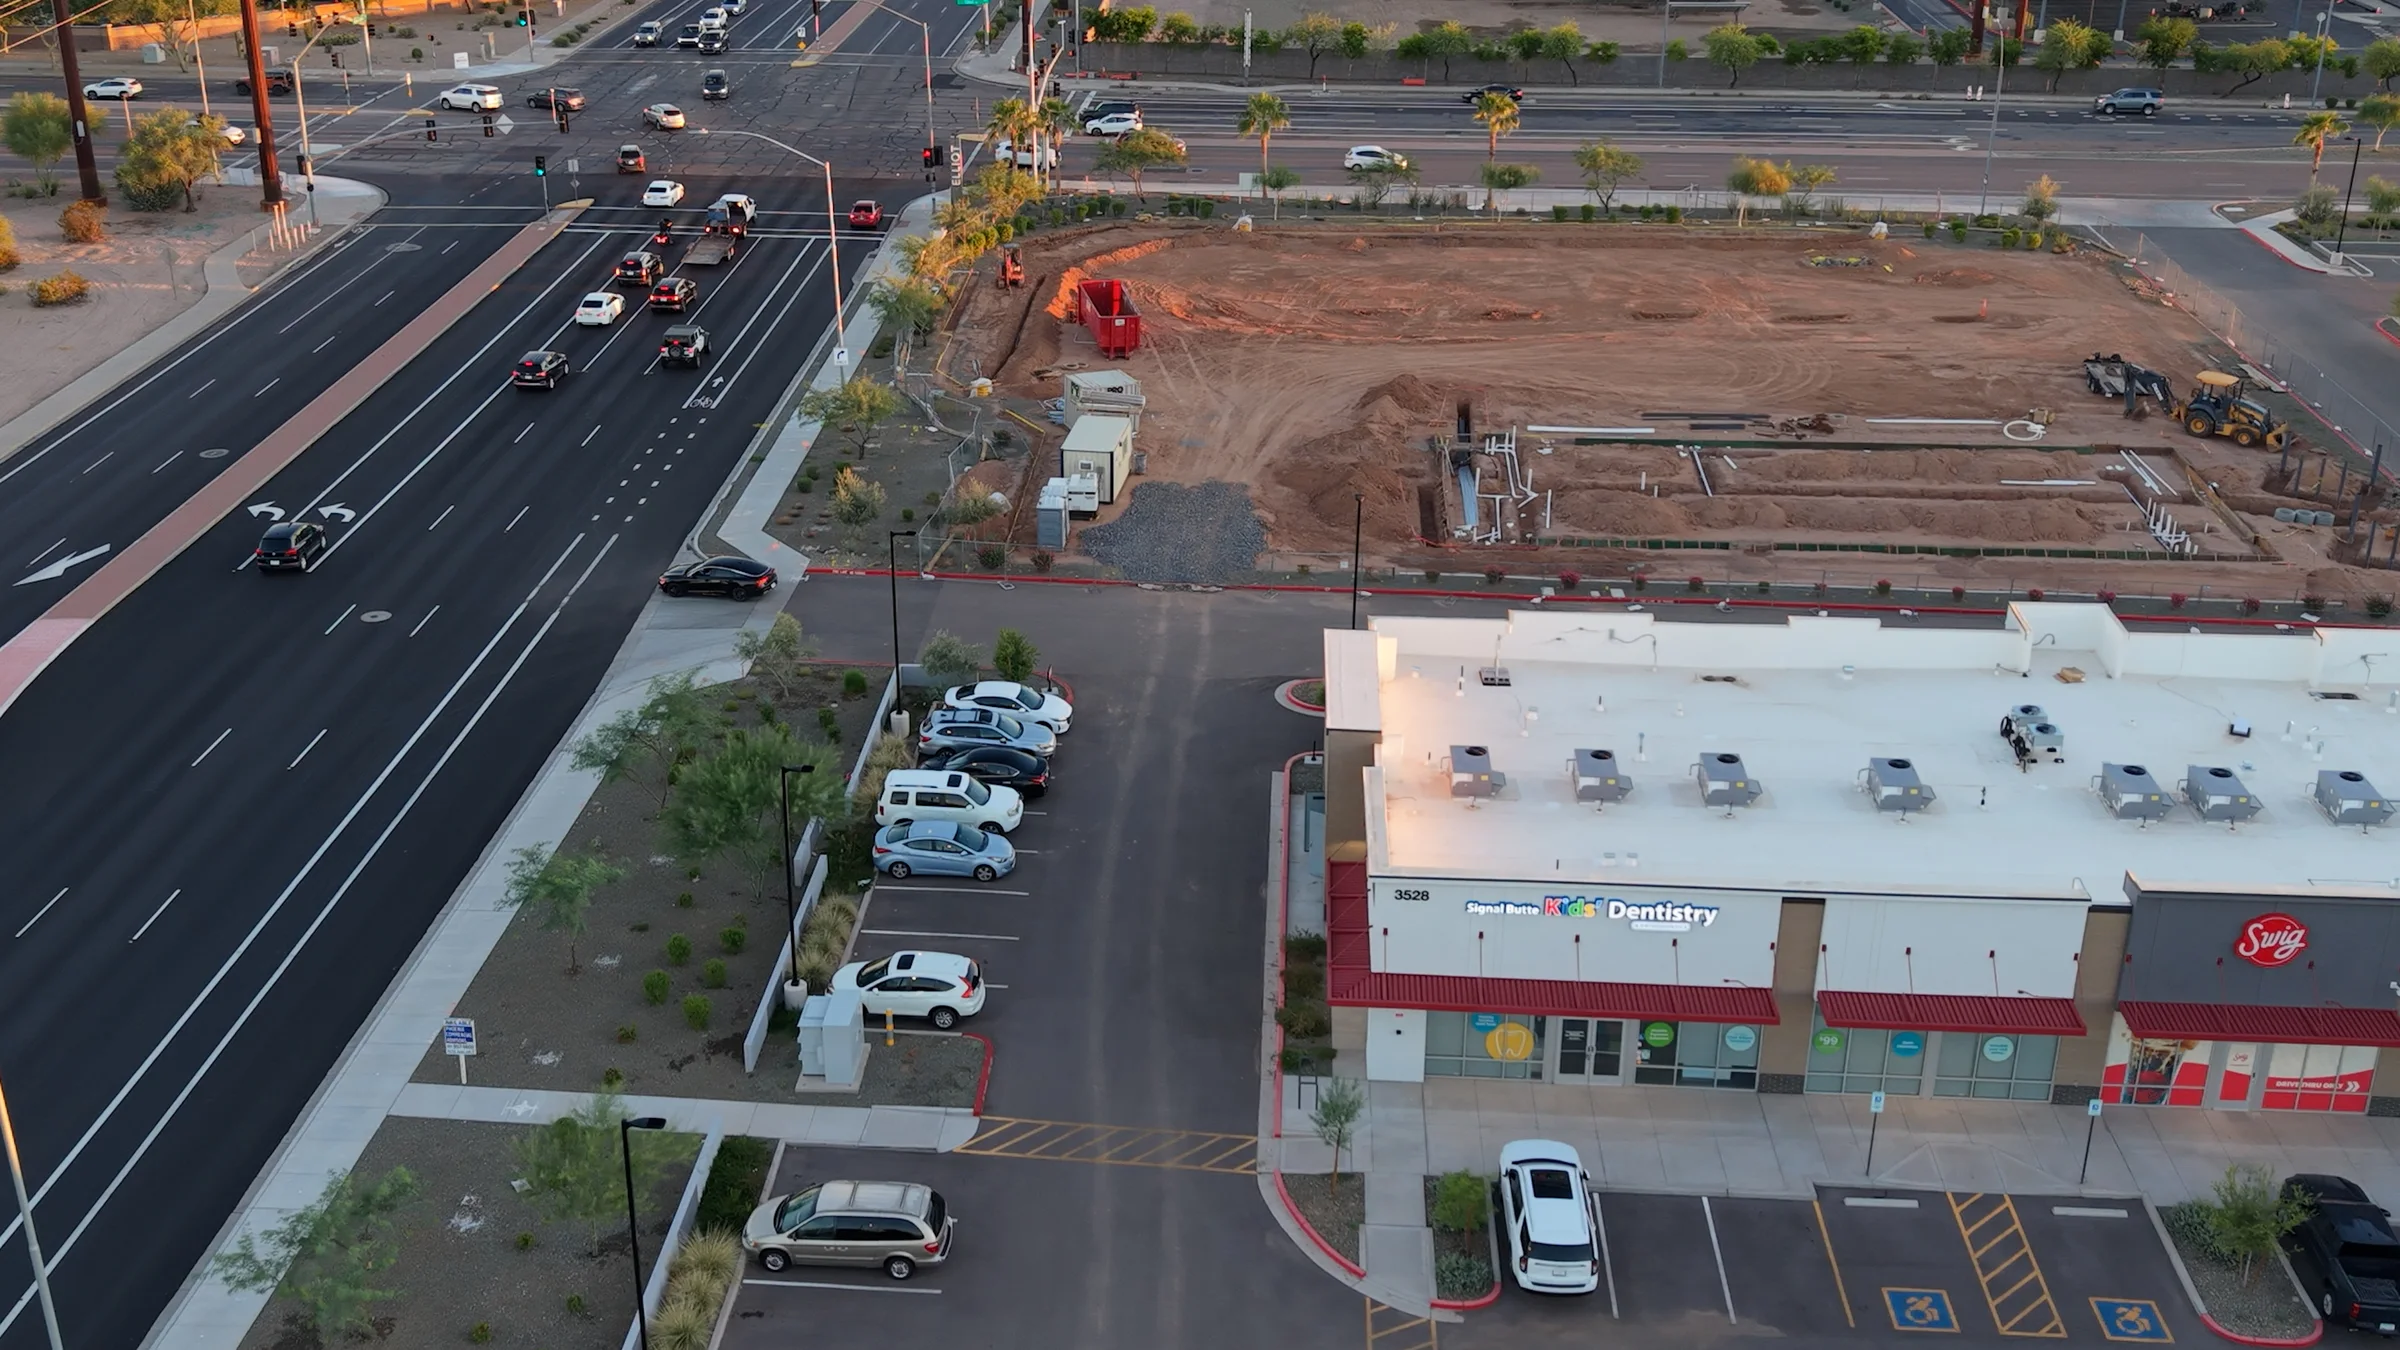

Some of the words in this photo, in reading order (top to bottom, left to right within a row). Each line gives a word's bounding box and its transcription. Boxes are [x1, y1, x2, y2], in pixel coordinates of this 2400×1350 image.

[950, 144, 962, 186] ELLIOT
[1394, 889, 1430, 901] 3528
[1466, 901, 1505, 915] Signal
[1505, 903, 1540, 915] Butte
[1608, 900, 1719, 927] Dentistry
[2238, 922, 2306, 960] Swig
